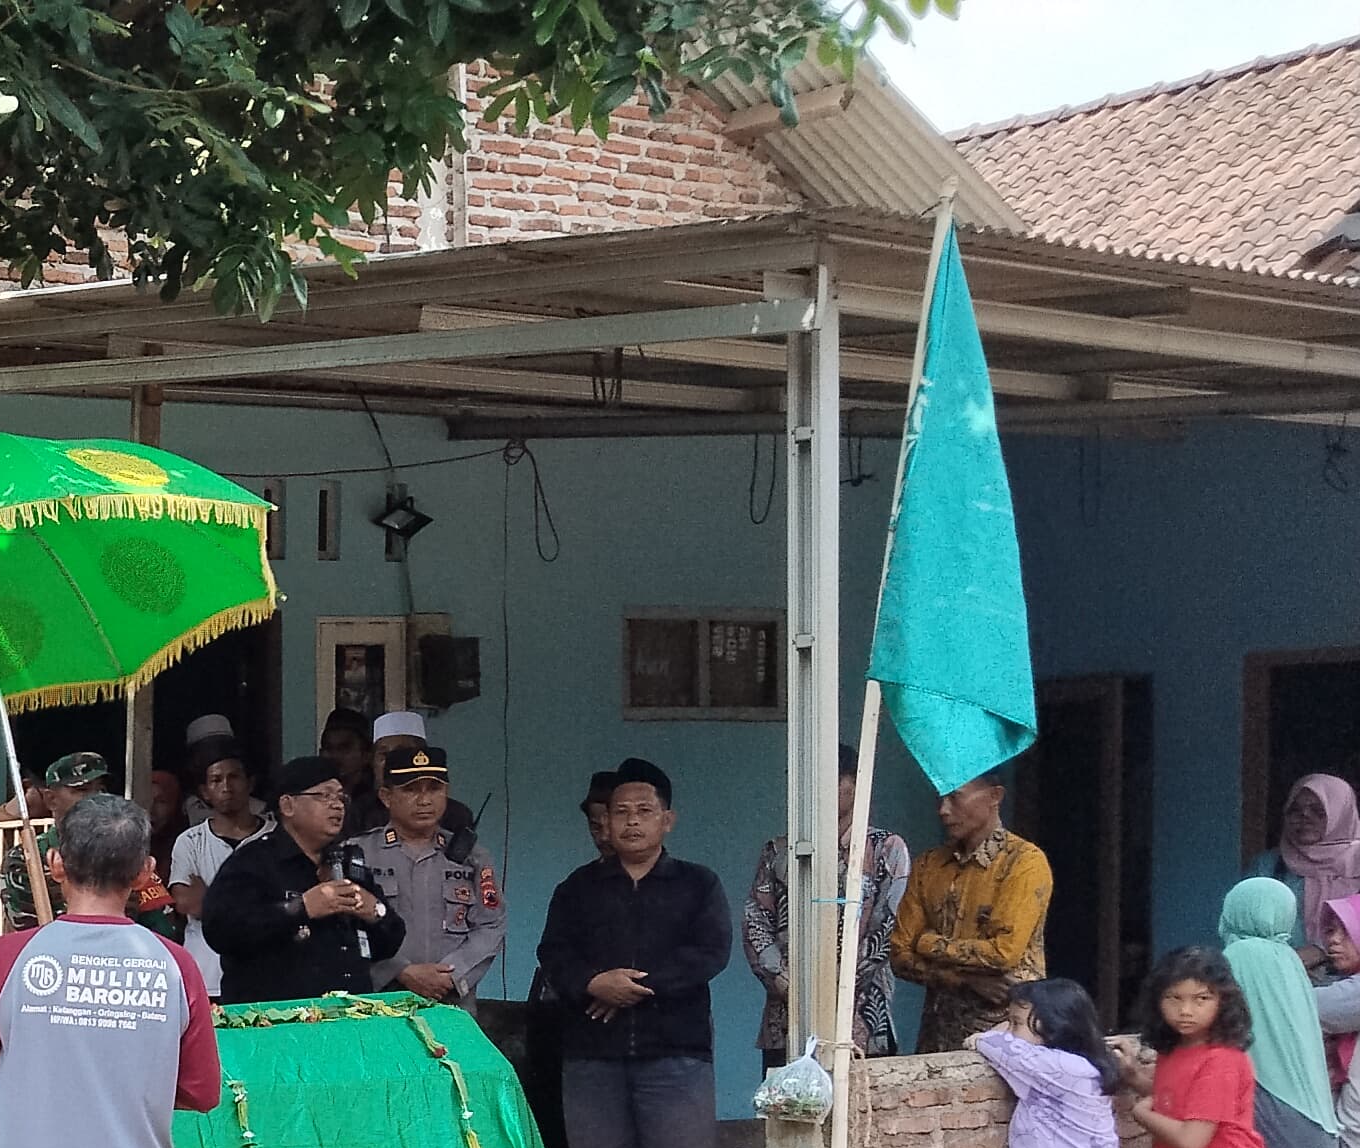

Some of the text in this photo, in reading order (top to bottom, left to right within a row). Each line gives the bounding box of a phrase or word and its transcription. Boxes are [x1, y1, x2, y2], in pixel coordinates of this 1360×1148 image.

[71, 954, 167, 969] BENGKEL GERGAJI
[67, 967, 168, 990] MULIYA
[66, 985, 167, 1008] BAROKAH
